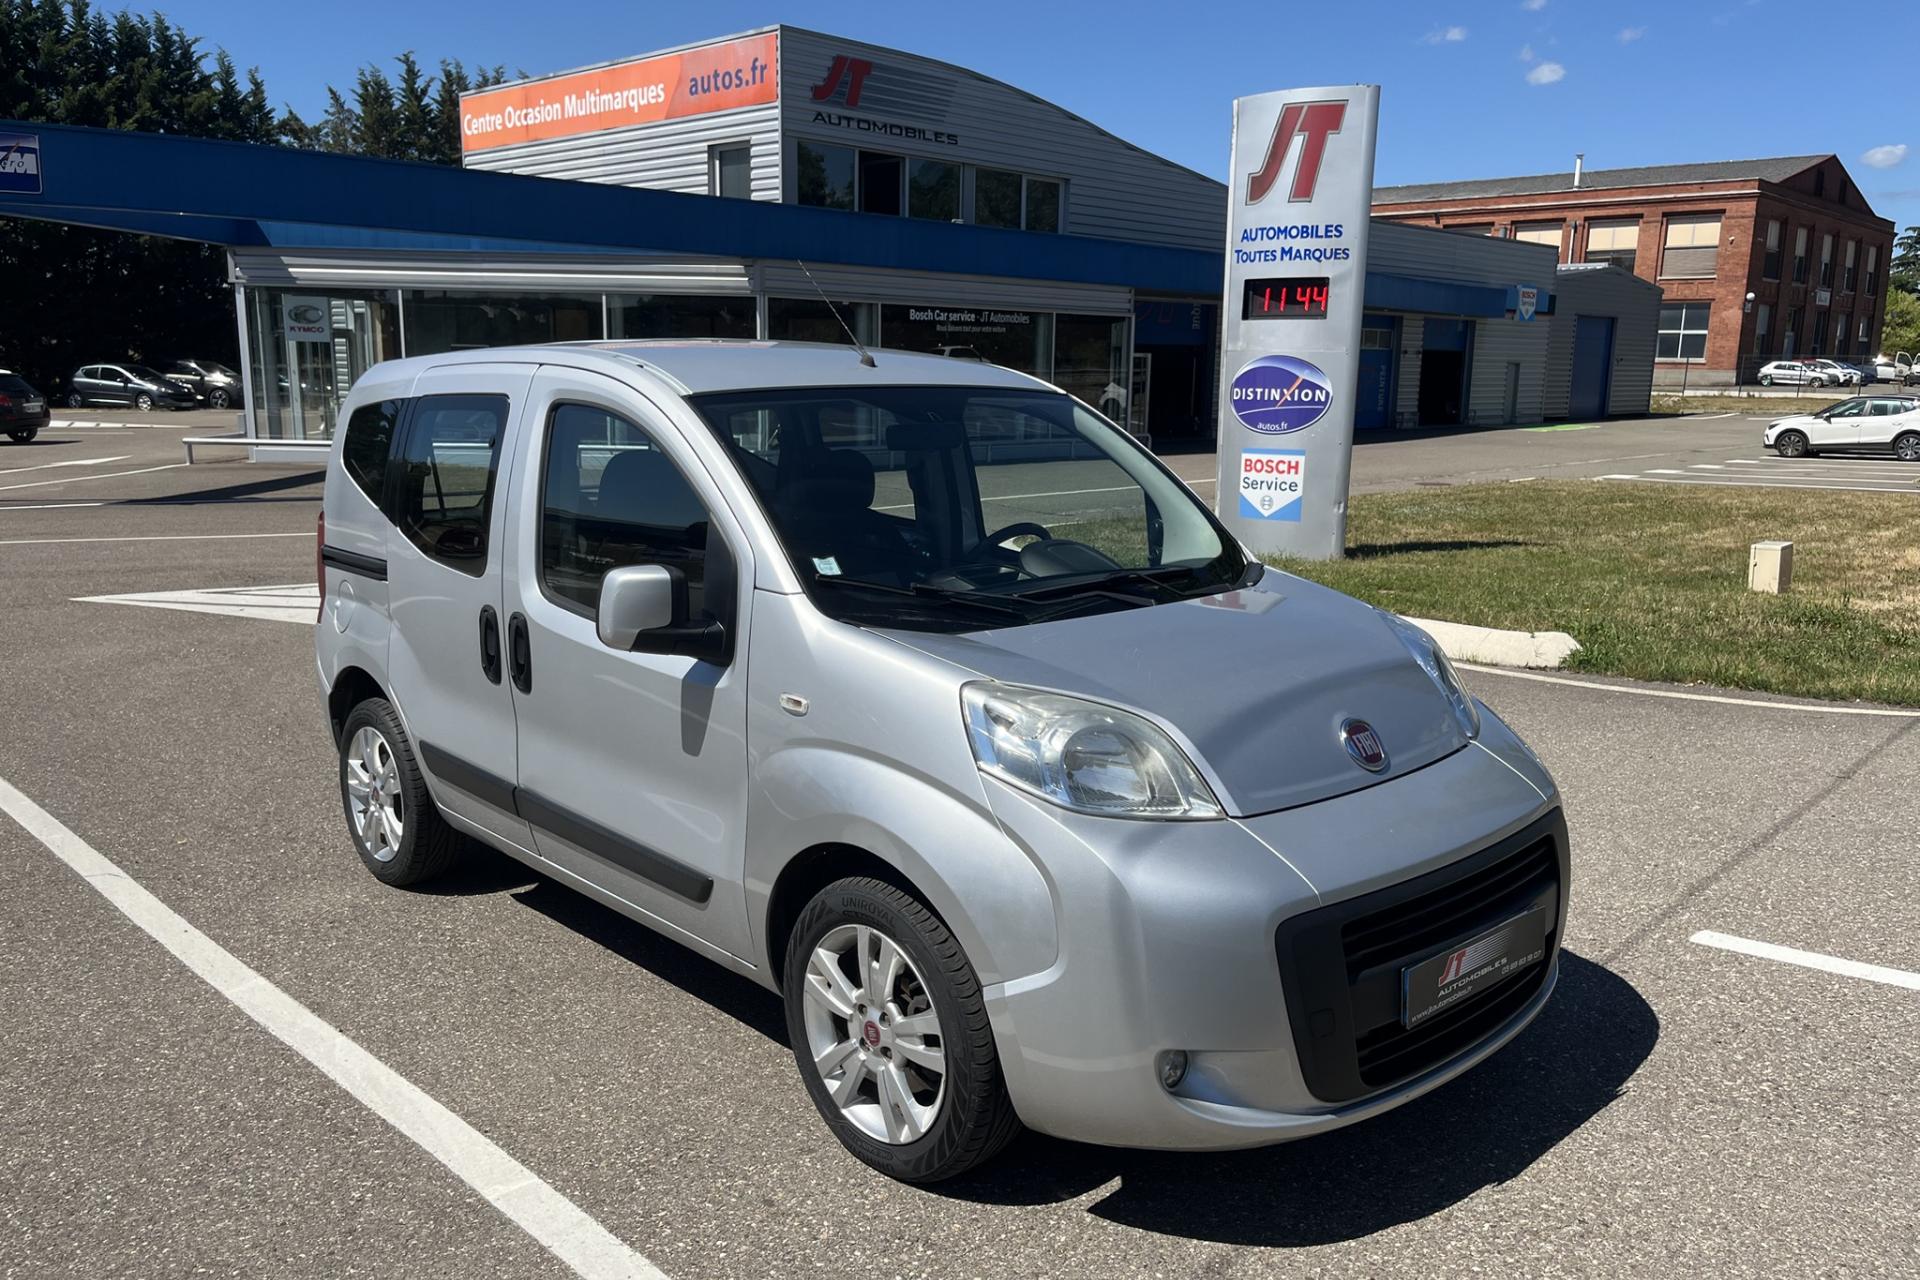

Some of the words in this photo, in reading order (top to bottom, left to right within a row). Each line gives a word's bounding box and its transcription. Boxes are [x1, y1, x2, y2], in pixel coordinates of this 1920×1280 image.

[811, 54, 873, 109] JT
[464, 112, 502, 136] Centre
[505, 99, 561, 129] Occasion
[564, 82, 665, 120] Multimarques
[689, 57, 768, 96] autos.fr
[812, 111, 959, 145] AUTOMOBILES
[1245, 99, 1349, 206] JT
[1240, 224, 1344, 243] AUTOMOBILES
[1234, 249, 1277, 264] TOUTES
[1280, 246, 1350, 263] MARQUES
[909, 309, 933, 321] Bosch
[935, 310, 948, 321] Car
[949, 311, 976, 322] service
[990, 313, 1030, 324] Automobiles
[289, 325, 324, 333] KYMCO
[1233, 387, 1326, 402] DISTINXION
[1257, 421, 1288, 431] autos.fr
[1244, 458, 1299, 475] BOSCH
[1242, 476, 1298, 492] Service
[1351, 731, 1380, 757] FIAT
[841, 896, 897, 928] UNIROYAL
[1437, 957, 1508, 998] AUTOMOBILES
[1438, 949, 1468, 987] JT
